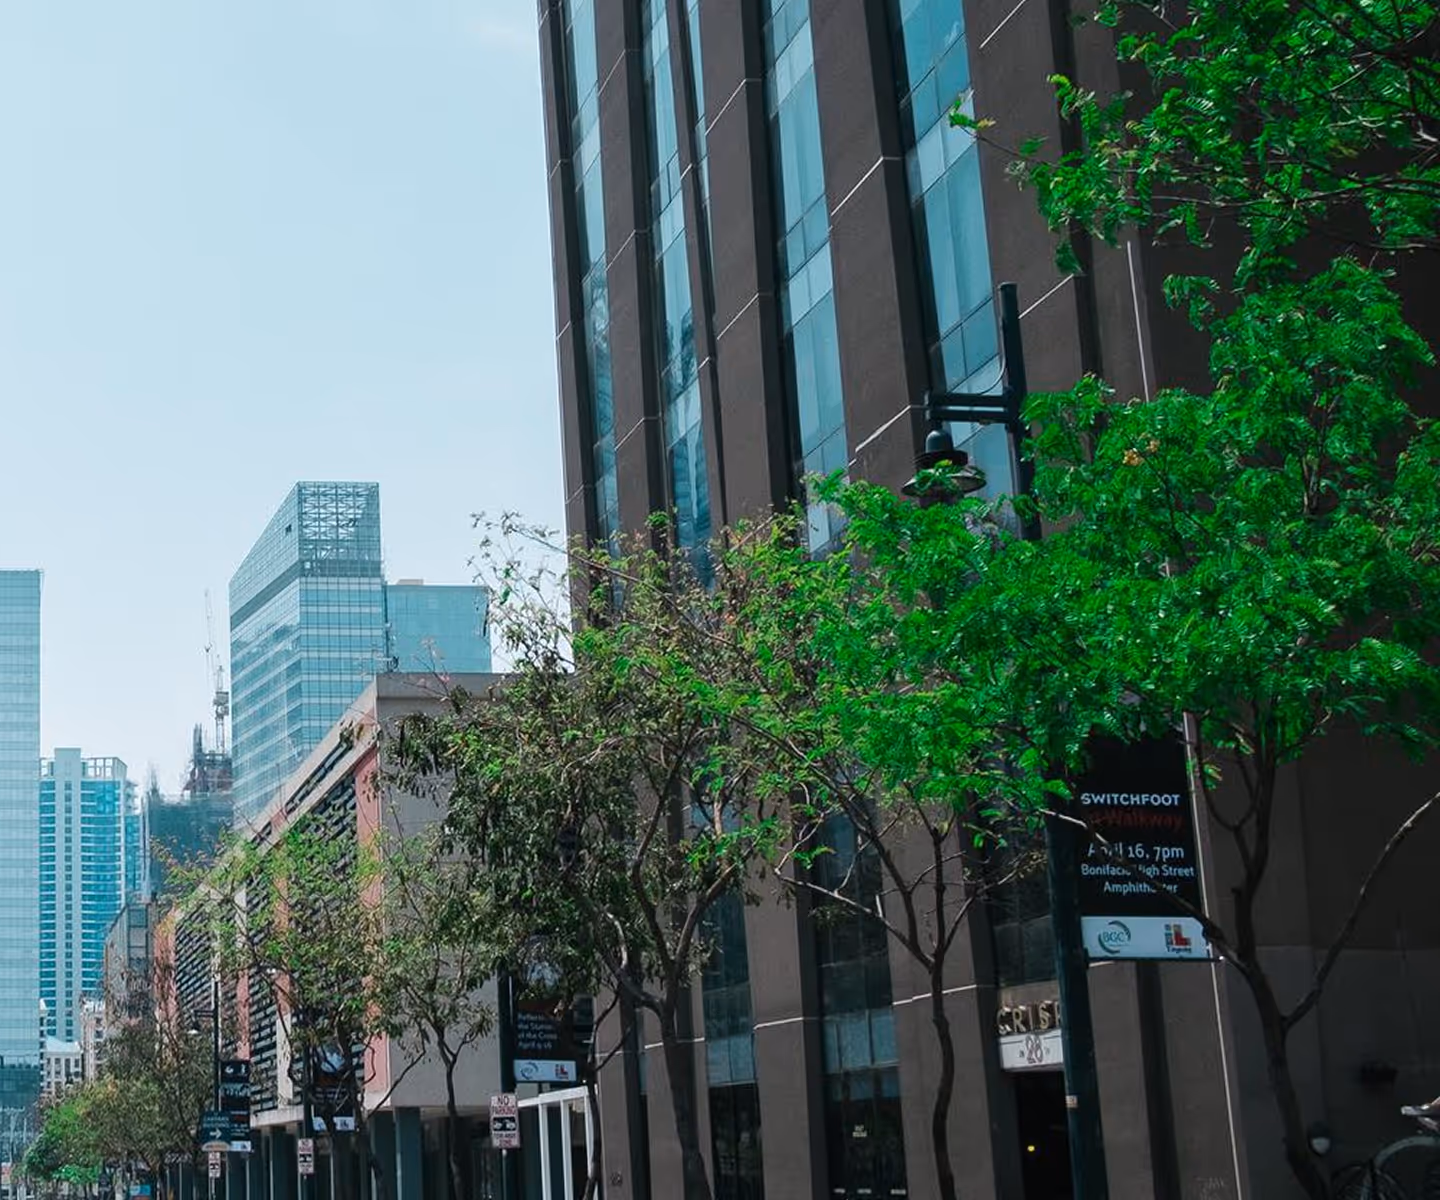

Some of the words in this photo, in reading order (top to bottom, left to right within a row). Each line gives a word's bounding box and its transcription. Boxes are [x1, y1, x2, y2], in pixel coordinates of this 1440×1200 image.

[1080, 792, 1180, 806] SWITCHFOOT
[1153, 846, 1185, 862] 7pm
[1162, 864, 1195, 877] Street
[1103, 881, 1178, 895] Amphither
[497, 1095, 510, 1106] NO
